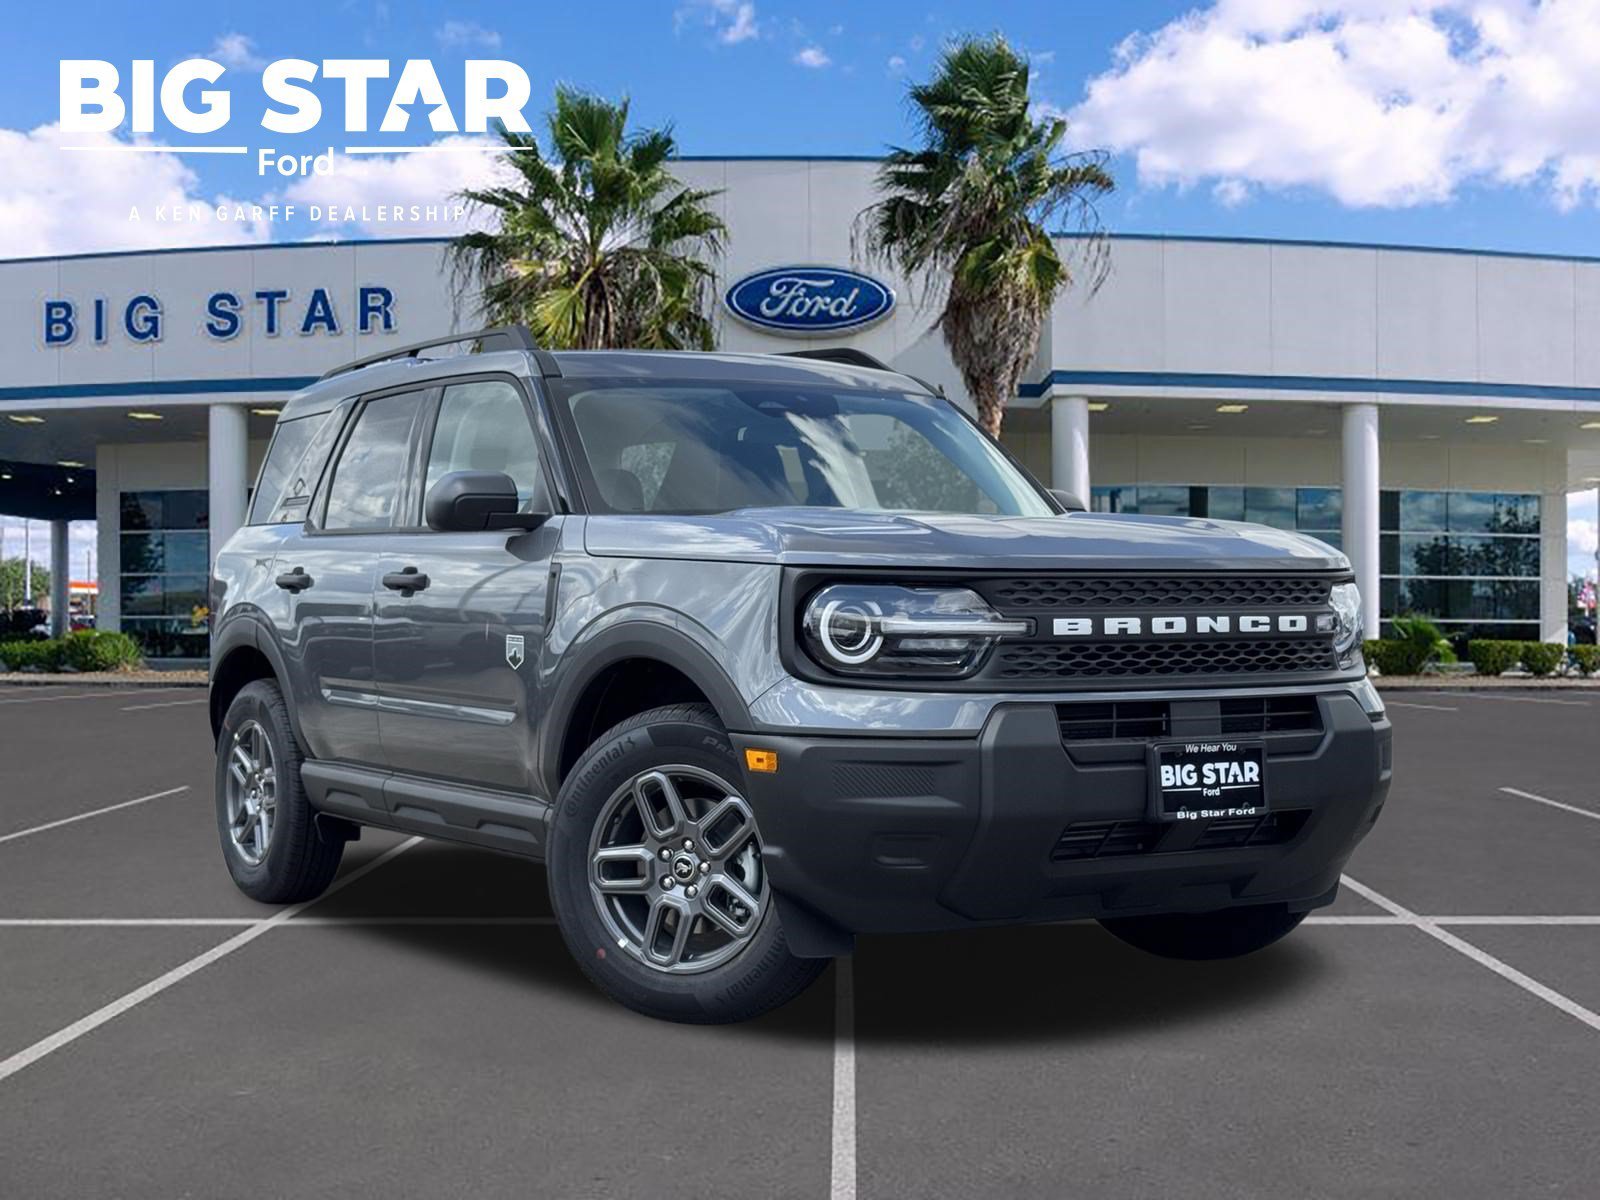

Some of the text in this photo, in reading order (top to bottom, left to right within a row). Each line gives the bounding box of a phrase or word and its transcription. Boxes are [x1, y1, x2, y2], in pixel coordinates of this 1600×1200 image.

[759, 277, 860, 318] Ford
[45, 287, 397, 345] BIG STAR
[1053, 615, 1307, 636] BRONCO
[1185, 742, 1237, 753] We Hear You
[1160, 761, 1259, 787] BIG STAR
[1203, 787, 1220, 797] Ford
[1176, 807, 1256, 820] Big Star Ford
